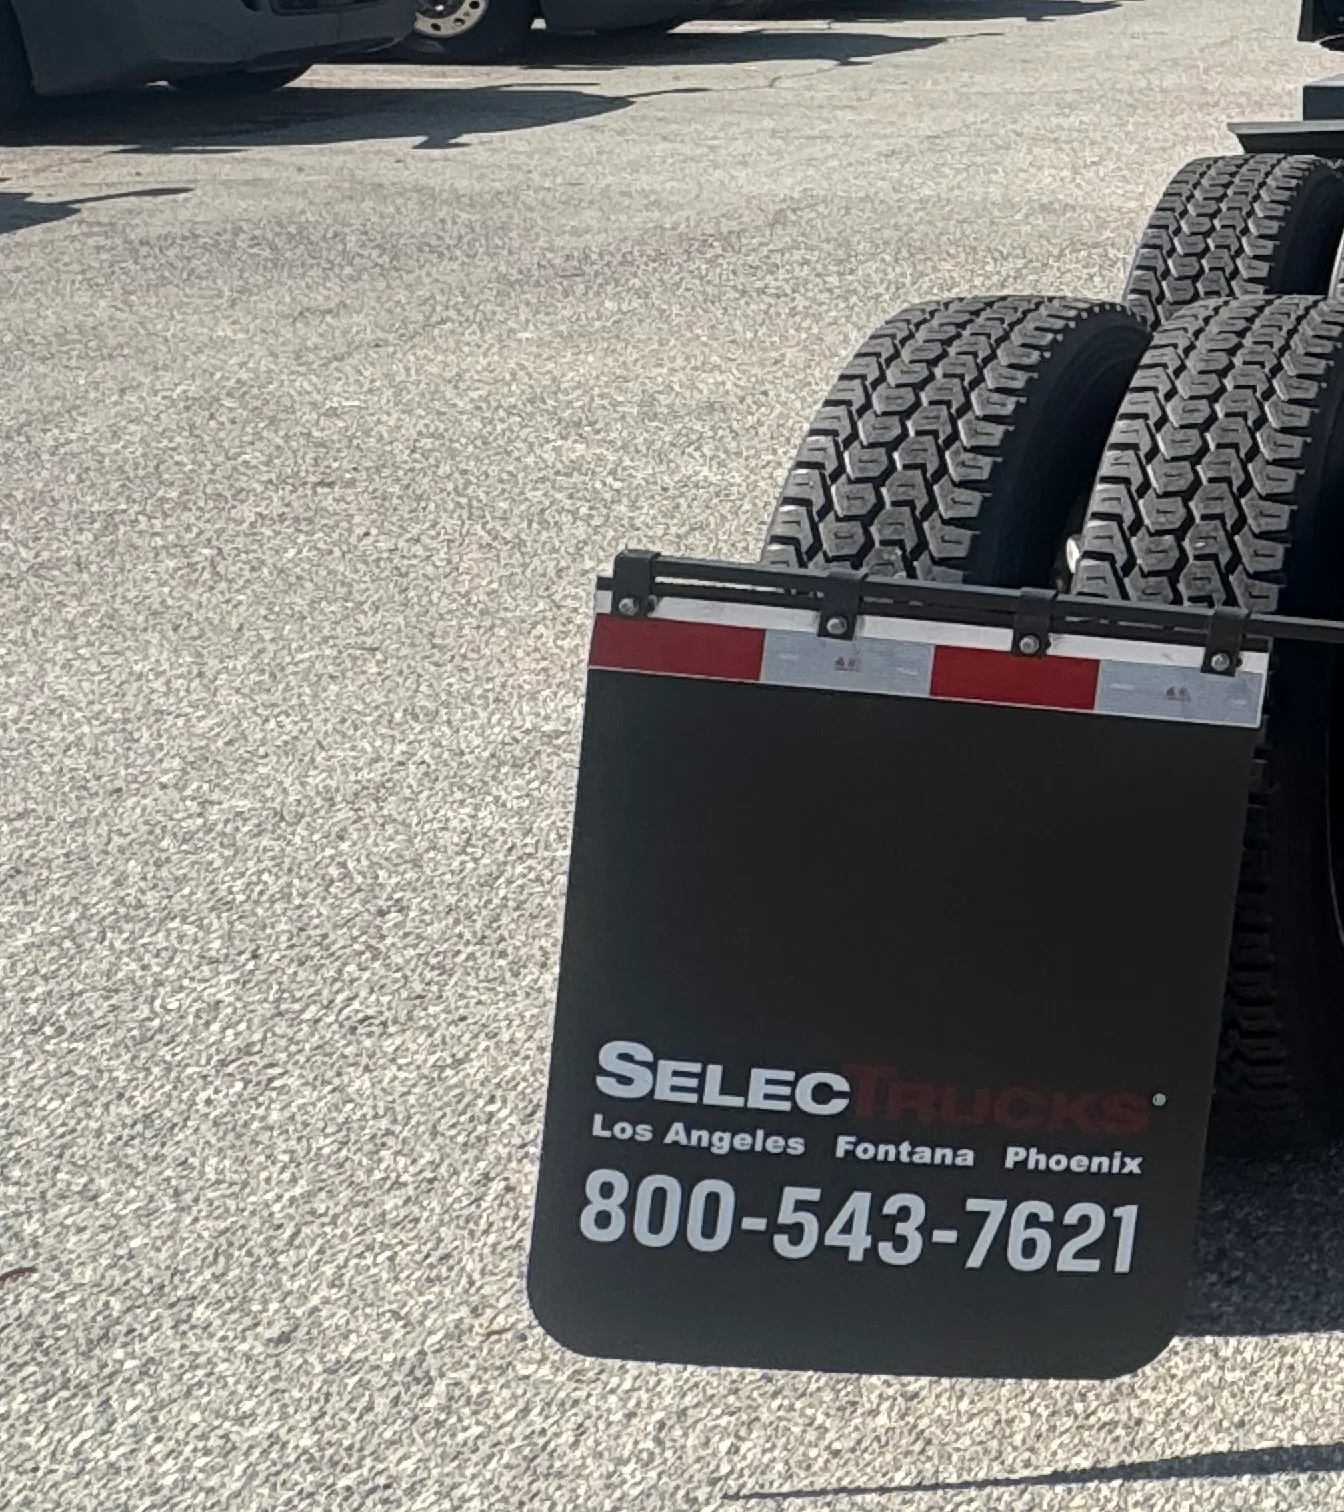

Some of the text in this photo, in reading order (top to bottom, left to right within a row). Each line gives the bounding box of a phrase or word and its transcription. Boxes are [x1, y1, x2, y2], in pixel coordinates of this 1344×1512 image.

[592, 1114, 1143, 1175] Los Angeles Fontana Phoenix
[579, 1168, 1139, 1274] 800-543-7621
